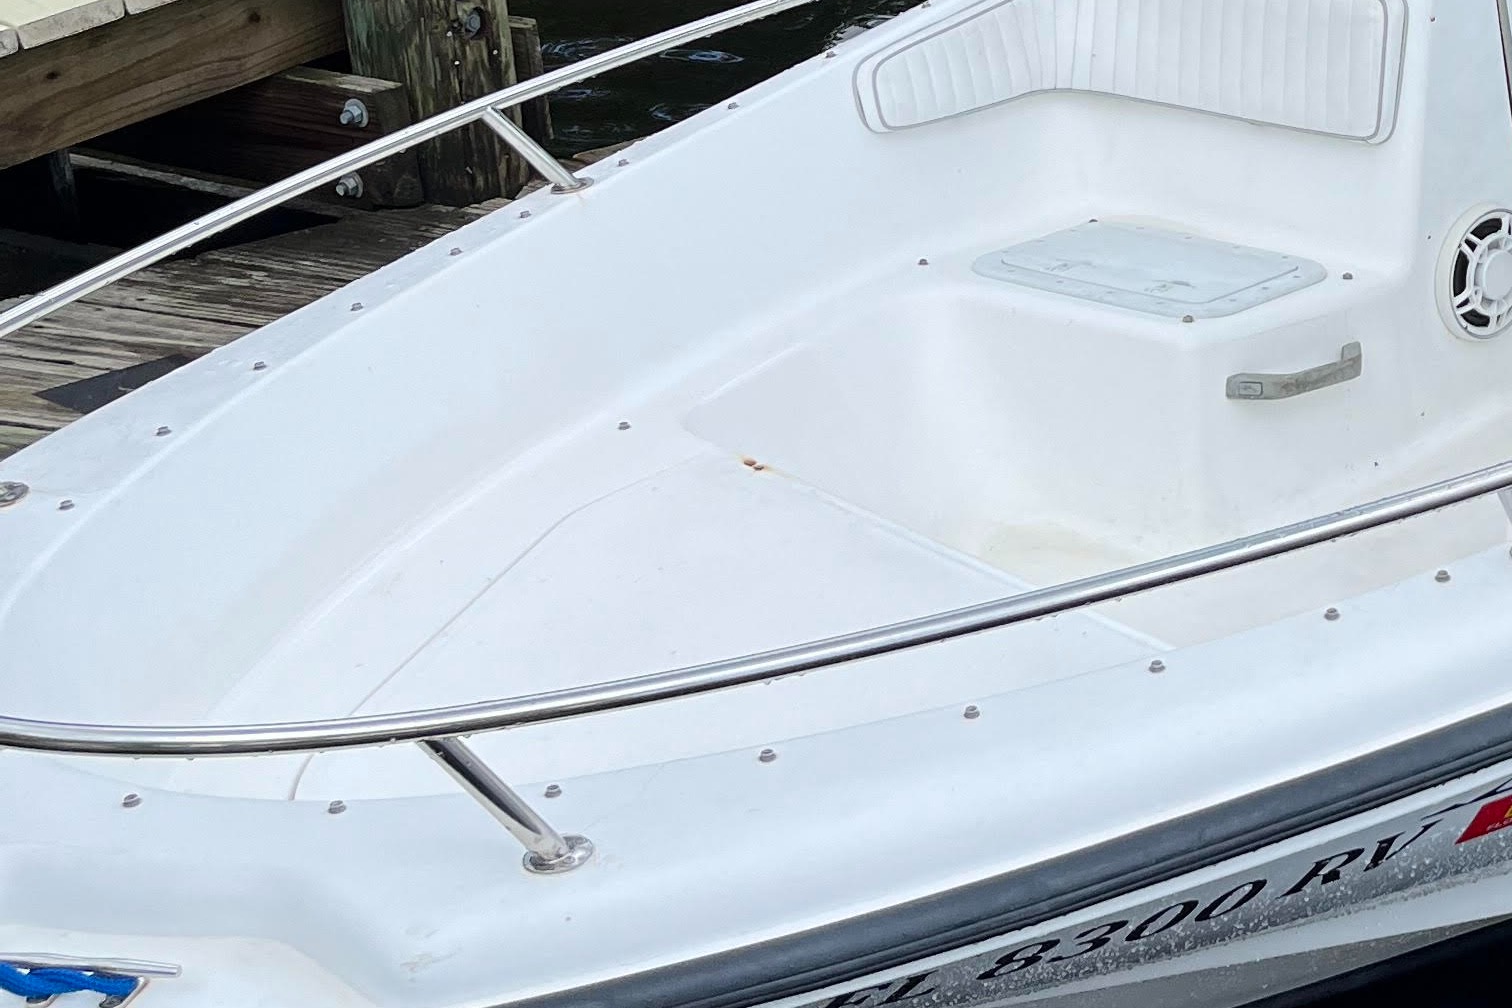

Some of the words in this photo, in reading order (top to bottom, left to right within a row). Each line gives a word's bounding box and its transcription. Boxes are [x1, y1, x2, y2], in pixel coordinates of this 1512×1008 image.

[824, 969, 938, 1008] FL
[976, 879, 1268, 981] 8300
[1276, 818, 1445, 900] RV
